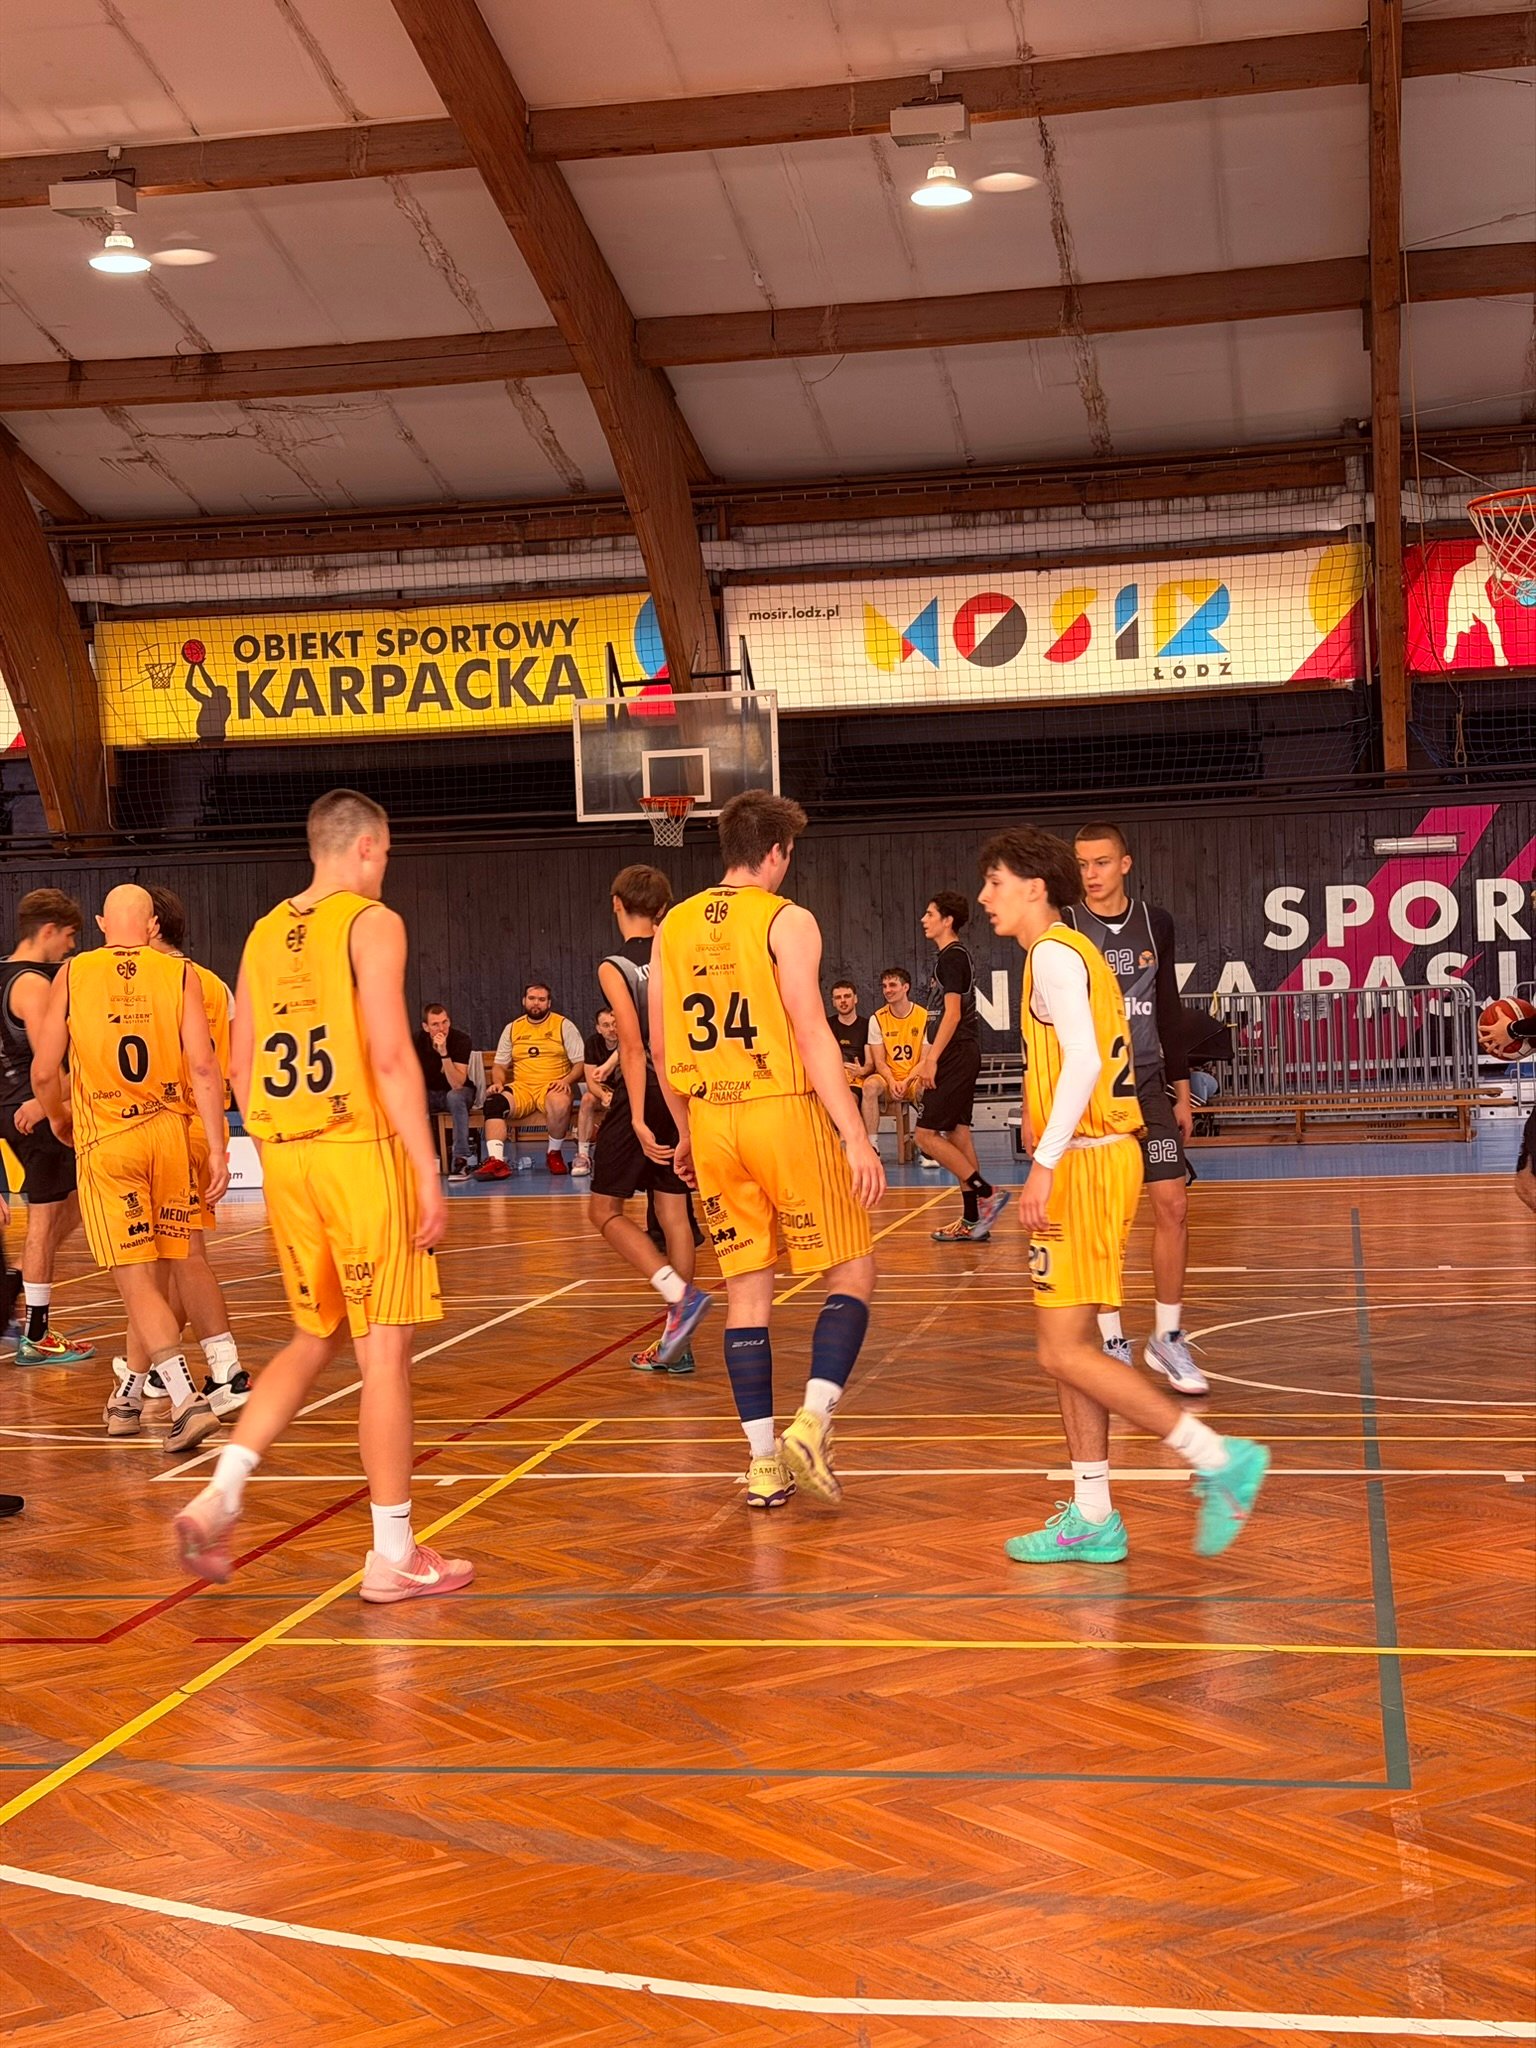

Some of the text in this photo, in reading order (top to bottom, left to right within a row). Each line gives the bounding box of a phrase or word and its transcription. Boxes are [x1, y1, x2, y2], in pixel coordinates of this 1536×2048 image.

[749, 604, 839, 621] mosir.lodz.pl
[864, 578, 1231, 672] MOSIR
[233, 617, 580, 664] OBIEKT SPORTOWY
[1153, 657, 1232, 680] ŁÓDŹ
[236, 654, 588, 720] KARPACKA
[1263, 877, 1533, 951] SPOR
[1104, 949, 1135, 975] 92
[1302, 951, 1536, 1020] PASJ
[1123, 996, 1153, 1021] jko
[682, 991, 758, 1052] 34
[118, 1035, 149, 1082] 0
[263, 1024, 334, 1097] 35
[527, 1046, 540, 1058] 9
[893, 1044, 913, 1061] 29
[1110, 1034, 1138, 1098] 2
[709, 1091, 744, 1102] FINANSE
[711, 1080, 752, 1092] JASZCZAK
[1147, 1139, 1178, 1164] 92
[160, 1206, 191, 1223] MEDIC
[716, 1238, 754, 1258] lthTeam
[752, 1466, 778, 1476] DAME
